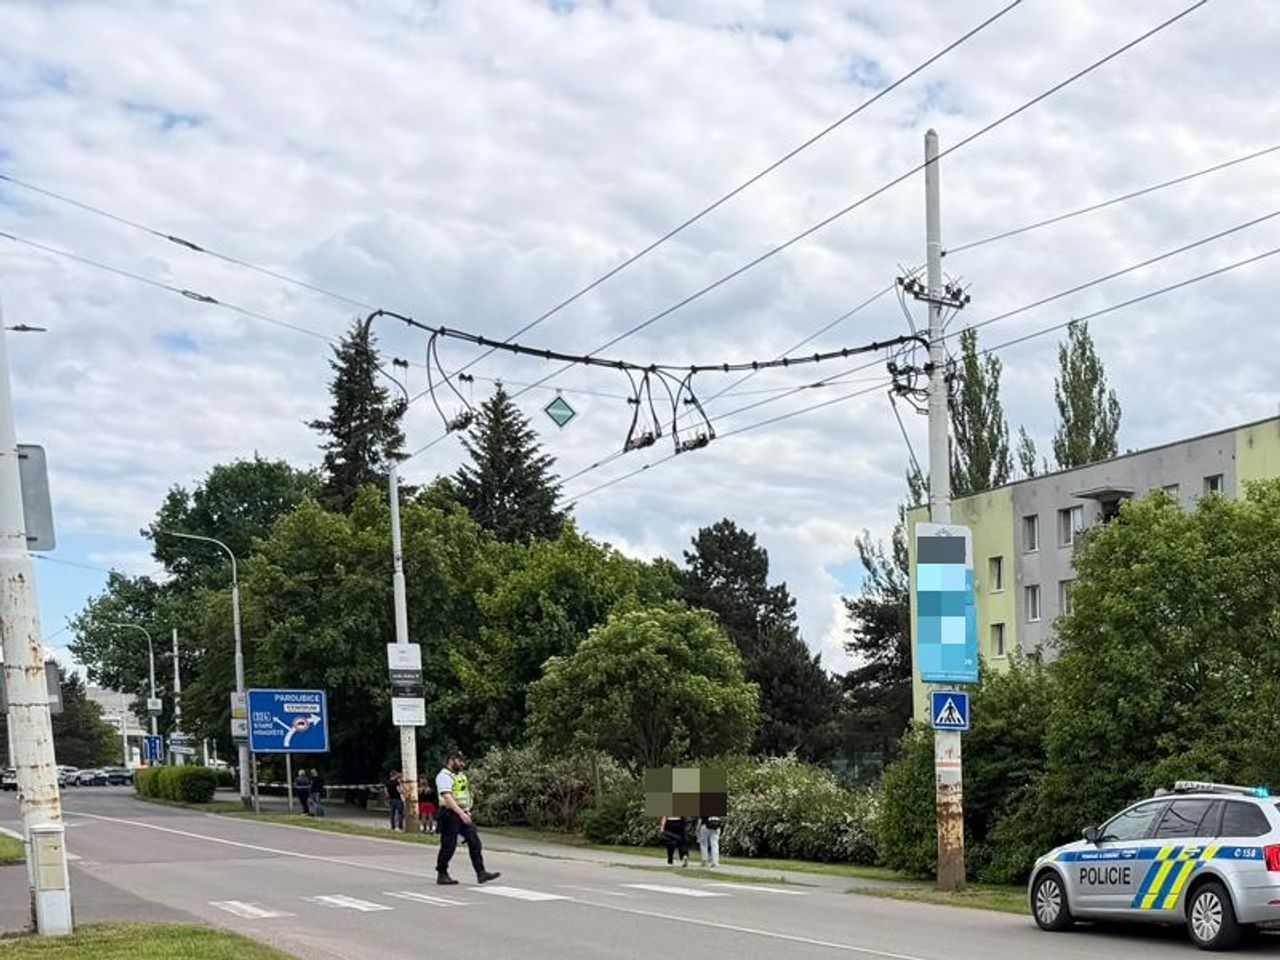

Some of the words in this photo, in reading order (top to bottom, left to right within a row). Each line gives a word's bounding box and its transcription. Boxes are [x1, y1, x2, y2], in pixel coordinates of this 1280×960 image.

[274, 694, 321, 702] PARDUBICE
[1242, 848, 1256, 857] 158
[1080, 867, 1131, 885] POLICIE
